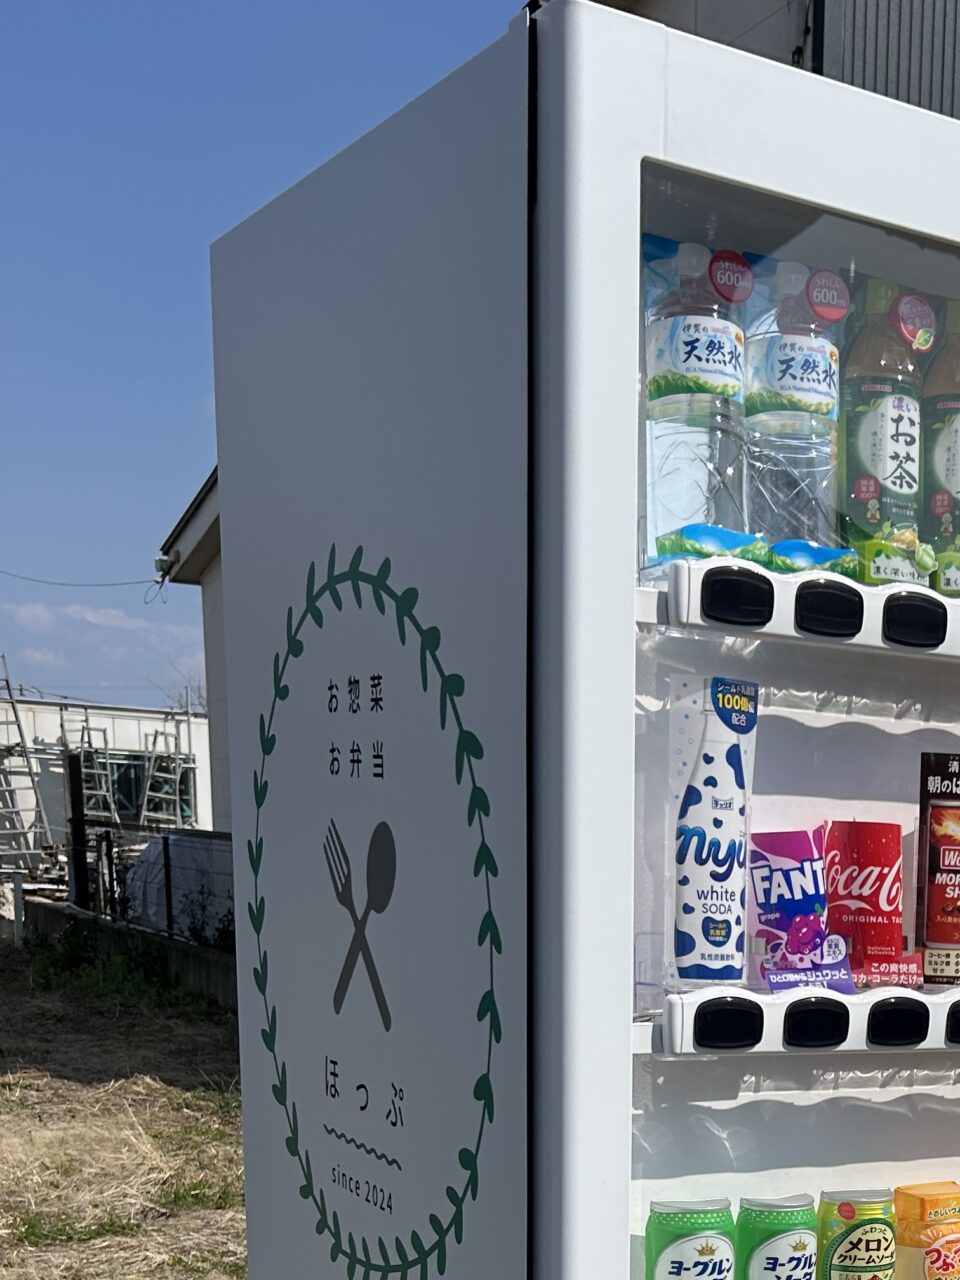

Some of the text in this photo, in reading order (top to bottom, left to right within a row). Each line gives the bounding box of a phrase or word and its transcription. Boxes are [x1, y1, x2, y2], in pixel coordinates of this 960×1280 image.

[682, 338, 743, 372] 天然水
[777, 356, 837, 389] 天然水
[892, 396, 918, 413] 濃い
[883, 413, 920, 490] お茶
[327, 673, 384, 713] お惣菜
[731, 712, 747, 727] 配合
[329, 739, 385, 780] お弁当
[825, 849, 903, 912] Coca-C
[696, 886, 736, 902] white
[701, 903, 733, 915] SODA
[759, 912, 781, 923] grape
[842, 914, 889, 923] ORIGINAL
[331, 1163, 393, 1216] since 2024
[861, 1225, 888, 1236] ふわっと
[845, 1236, 895, 1254] メロン
[668, 1258, 733, 1277] ヨーグルン
